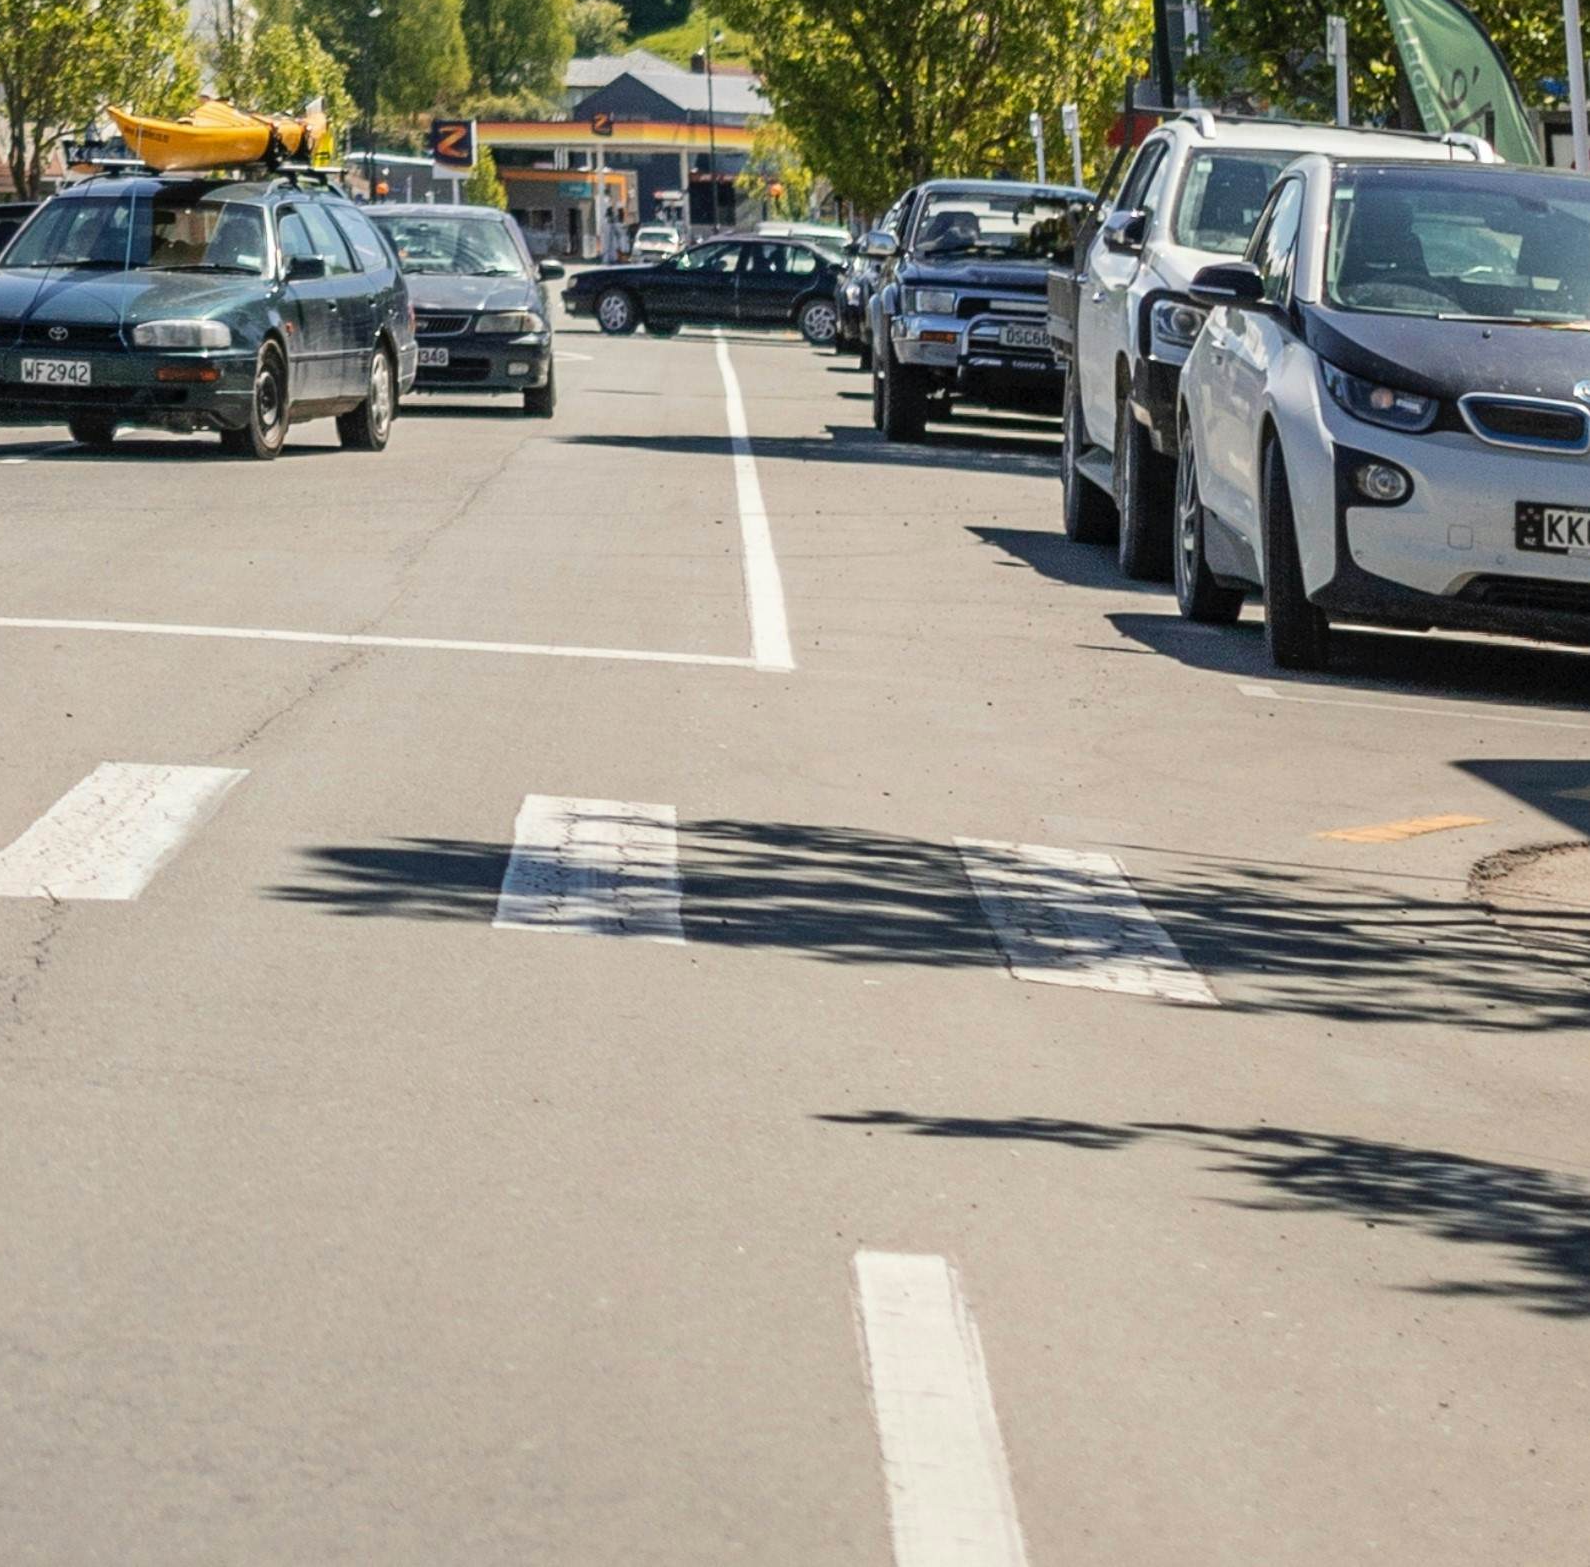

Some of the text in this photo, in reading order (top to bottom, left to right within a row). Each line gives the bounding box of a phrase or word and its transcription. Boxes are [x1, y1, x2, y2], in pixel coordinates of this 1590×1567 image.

[437, 125, 468, 159] Z
[24, 362, 88, 383] WF2942
[1548, 514, 1590, 546] KK
